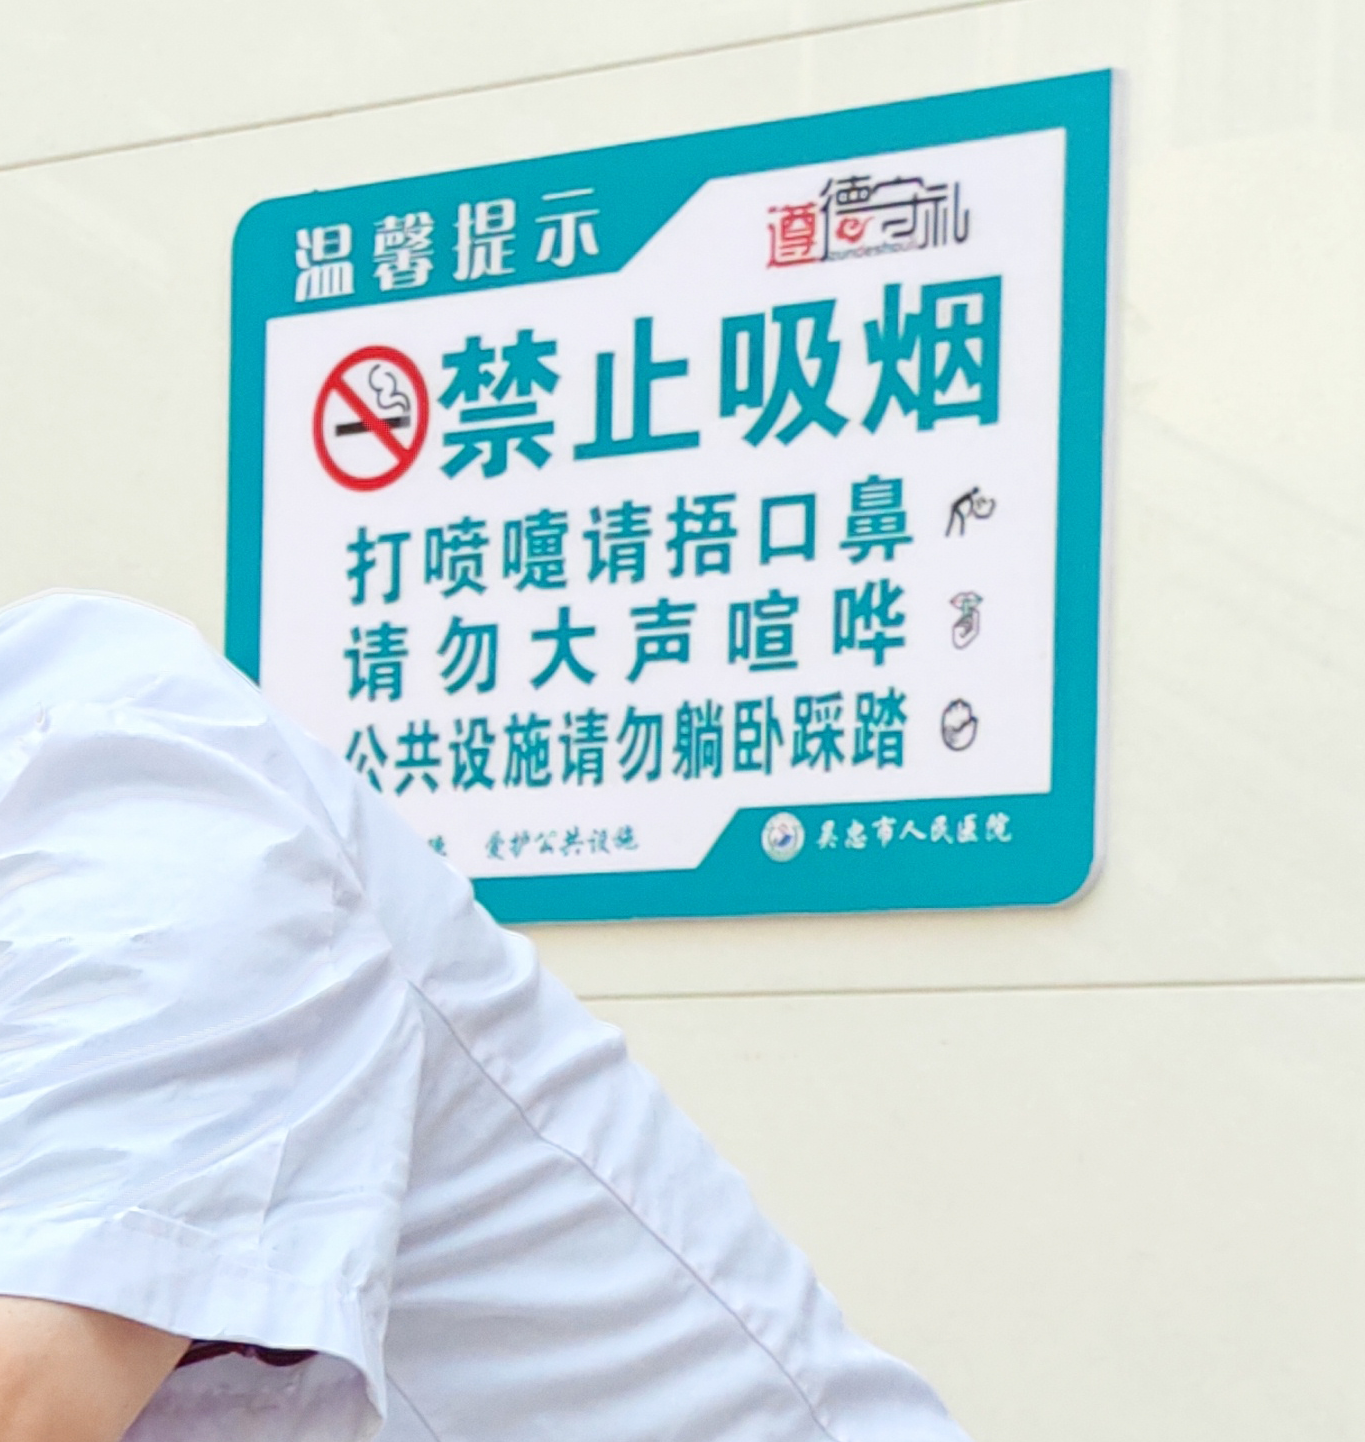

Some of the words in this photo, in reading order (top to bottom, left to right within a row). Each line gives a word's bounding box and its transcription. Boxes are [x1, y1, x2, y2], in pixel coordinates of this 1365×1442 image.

[294, 188, 601, 302] 温馨提示
[438, 275, 1004, 479] 禁止吸烟
[345, 474, 915, 605] 打喷嚏请捂口鼻
[342, 579, 907, 704] 请勿大声喧哗
[344, 687, 908, 796] 公共设施请勿躺卧踩踏
[485, 825, 640, 860] 爱护公共设施
[816, 812, 1012, 849] 吴忠市人民医院
